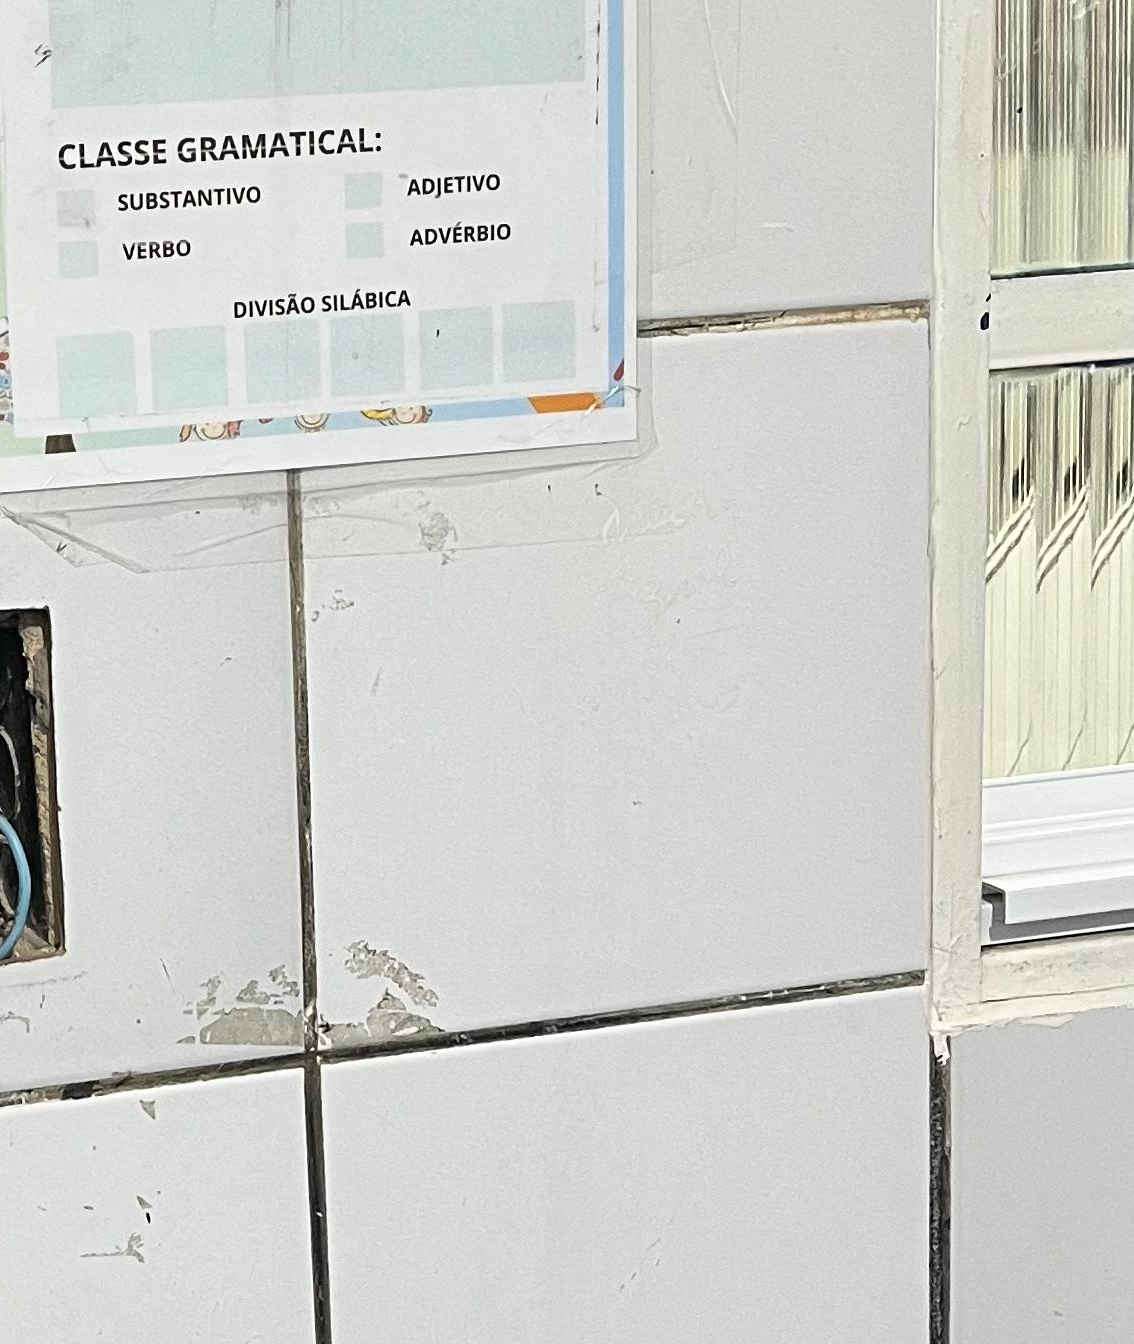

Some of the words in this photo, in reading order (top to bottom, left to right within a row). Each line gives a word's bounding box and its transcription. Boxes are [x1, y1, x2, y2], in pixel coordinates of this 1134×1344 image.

[58, 138, 167, 170] CLASSE
[177, 127, 383, 164] GRAMATICAL:
[117, 186, 262, 212] SUBSTANTIVO
[407, 173, 501, 199] ADJETIVO
[409, 222, 512, 247] ADVÉRBIO
[122, 239, 191, 261] VERBO
[233, 293, 316, 319] DIVISÃO
[321, 288, 412, 313] SILÁBICA
